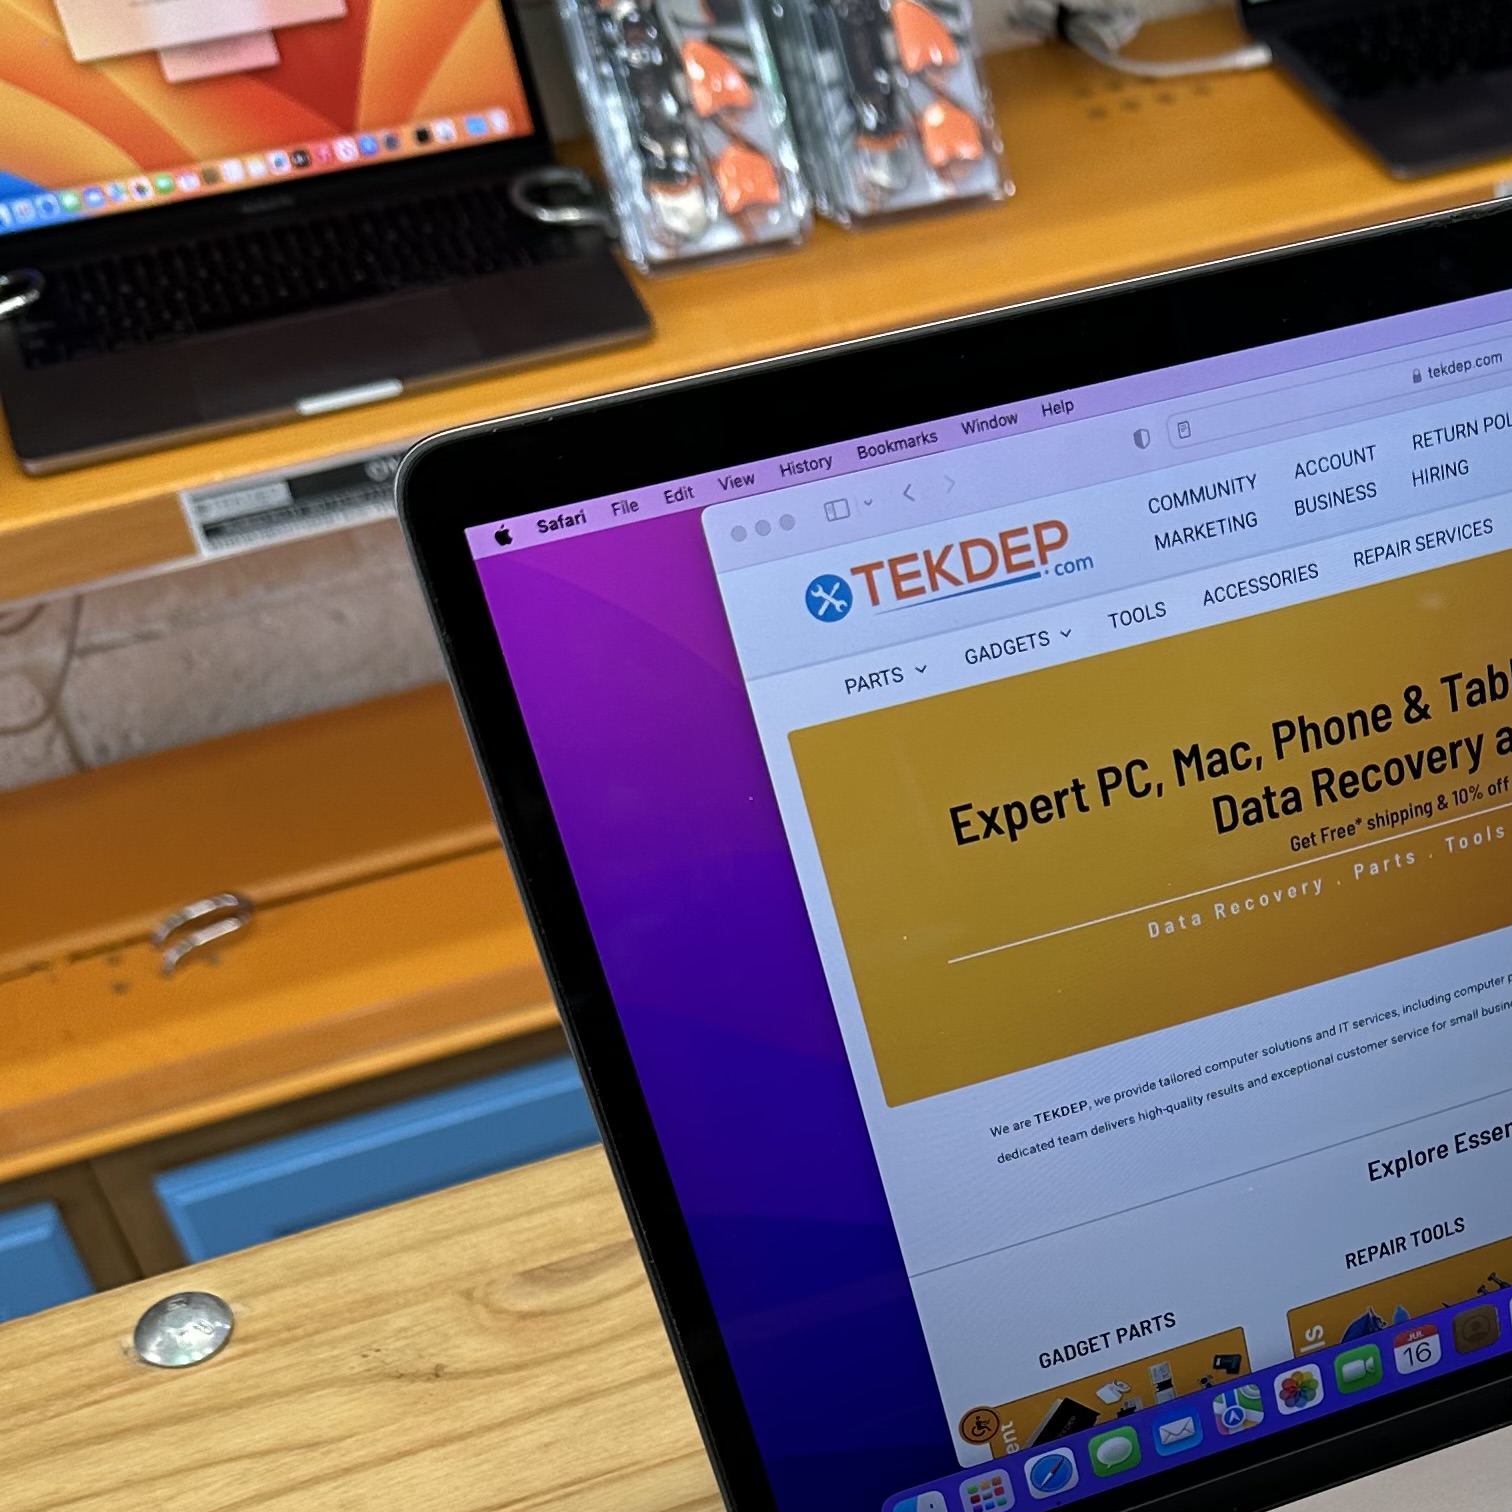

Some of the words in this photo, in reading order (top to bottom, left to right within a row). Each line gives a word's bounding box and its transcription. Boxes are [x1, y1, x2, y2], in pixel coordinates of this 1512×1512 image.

[1428, 353, 1503, 379] tekdep.com
[536, 509, 587, 534] Safari
[611, 500, 639, 516] File
[663, 486, 695, 505] Edit
[717, 474, 755, 491] View
[779, 456, 832, 477] History
[857, 432, 938, 460] Bookmarks
[961, 413, 1018, 435] Window
[1041, 400, 1074, 417] Help
[1148, 474, 1256, 514] COMMUNITY
[1295, 444, 1376, 479] ACCOUNT
[1412, 420, 1479, 450] RETURN
[1154, 511, 1258, 550] MARKETING
[1294, 481, 1377, 516] BUSINESS
[1412, 459, 1469, 487] HIRING
[844, 666, 904, 695] PARTS
[965, 630, 1050, 665] GADGETS
[1107, 601, 1167, 628] TOOLS
[1203, 563, 1319, 606] ACCESSORIES
[1353, 539, 1411, 567] REPAIR
[1415, 518, 1493, 552] SERVICES
[850, 519, 1069, 606] TEKDEP
[949, 778, 1090, 846] Expert
[1097, 758, 1163, 807] PC,
[1172, 741, 1262, 787] Mac,
[1272, 703, 1392, 760] Phone
[1403, 685, 1432, 724] &
[1212, 785, 1302, 834] Data
[1311, 734, 1484, 807] Recovery
[1290, 832, 1317, 852] Get
[1367, 801, 1433, 831] shipping
[1437, 794, 1448, 811] &
[1452, 784, 1483, 806] 10%
[1487, 776, 1509, 796] off
[1147, 913, 1202, 938] Data
[1214, 878, 1322, 920] Recovery
[1353, 852, 1415, 880] Parts
[1444, 825, 1505, 853] Tools
[989, 1125, 1010, 1137] We
[1013, 1119, 1032, 1131] are
[1093, 1095, 1111, 1106] we
[1113, 1081, 1156, 1104] provide
[1158, 1066, 1202, 1088] tailored
[1204, 1051, 1259, 1074] computer
[1262, 1035, 1313, 1057] solutions
[1316, 1025, 1336, 1041] and
[1339, 1021, 1348, 1033] IT
[1352, 1009, 1400, 1029] services,
[1402, 993, 1451, 1014] including
[1454, 976, 1504, 998] computer
[997, 1138, 1055, 1164] dedicated
[1057, 1130, 1088, 1146] team
[1090, 1116, 1136, 1136] delivers
[1137, 1095, 1204, 1121] high-quality
[1206, 1083, 1245, 1101] results
[1247, 1073, 1268, 1089] and
[1271, 1054, 1334, 1081] exceptional
[1336, 1039, 1388, 1061] customer
[1391, 1027, 1429, 1045] service
[1431, 1020, 1446, 1032] for
[1450, 1009, 1479, 1027] small
[1368, 1144, 1448, 1182] Explore
[1345, 1236, 1407, 1270] REPAIR
[1410, 1217, 1465, 1247] TOOLS
[1039, 1331, 1111, 1369] GADGET
[1116, 1312, 1176, 1344] PARTS
[1403, 1341, 1432, 1366] 16
